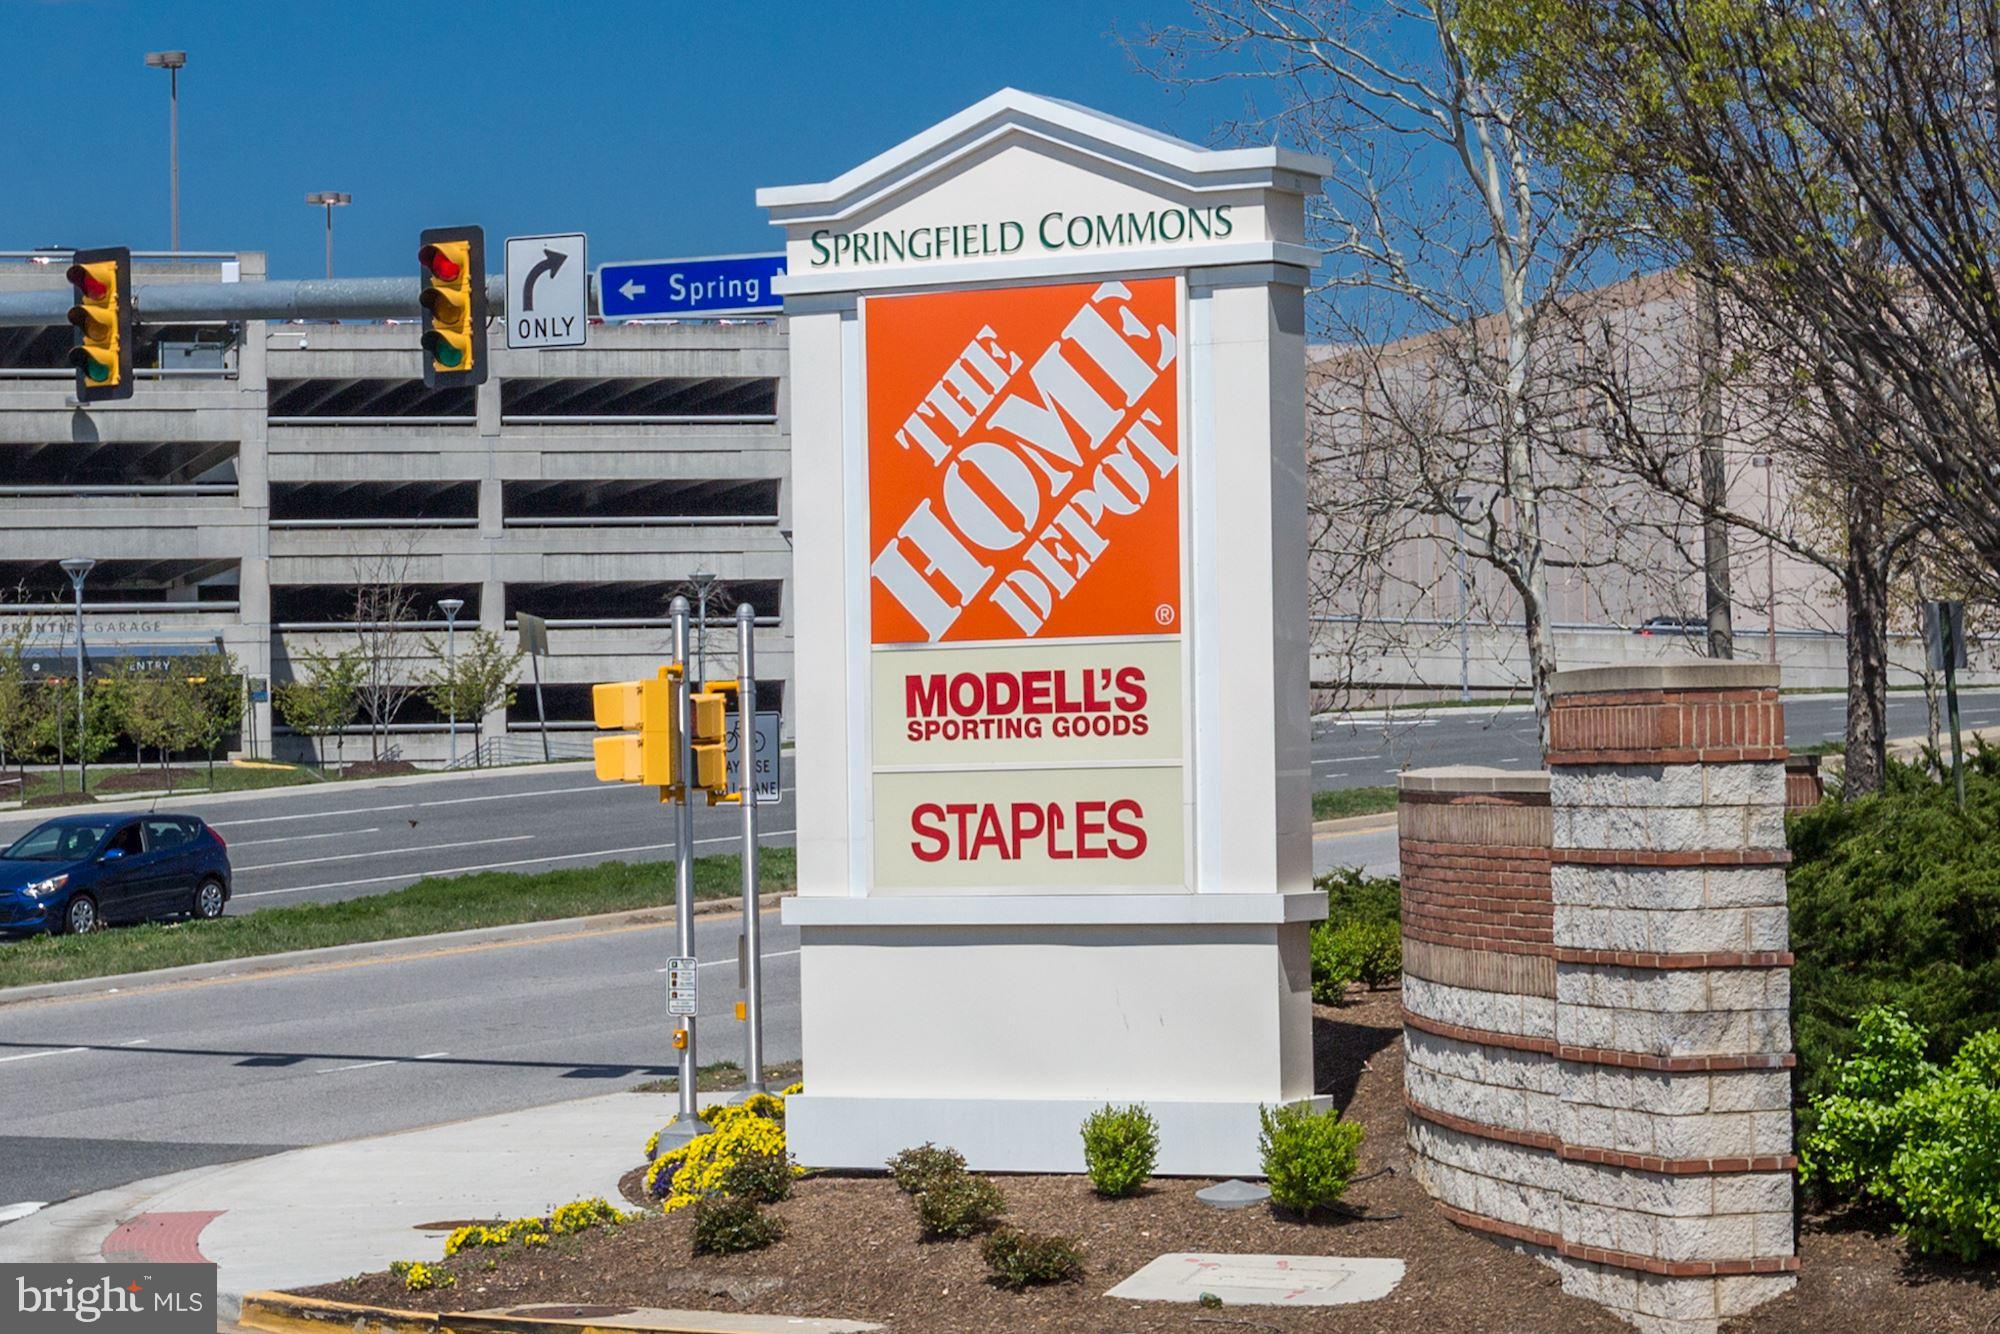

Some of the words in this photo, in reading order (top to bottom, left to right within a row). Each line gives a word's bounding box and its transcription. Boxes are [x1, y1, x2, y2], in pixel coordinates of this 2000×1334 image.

[810, 220, 1025, 267] SPRINGFIELD
[1038, 203, 1233, 251] COMMONS
[669, 273, 760, 306] Spring
[518, 316, 575, 339] ONLY
[894, 324, 1024, 468] THE
[871, 281, 1177, 643] HOME
[989, 407, 1179, 637] DEPOT
[2, 623, 85, 634] FRNTIE
[94, 621, 161, 633] GARAGE
[905, 667, 1148, 718] MODELL'S
[907, 717, 1042, 742] SPORTING
[1052, 714, 1149, 738] GOODS
[755, 760, 771, 773] SE
[752, 781, 776, 795] ANE
[911, 799, 1148, 862] STAPLES
